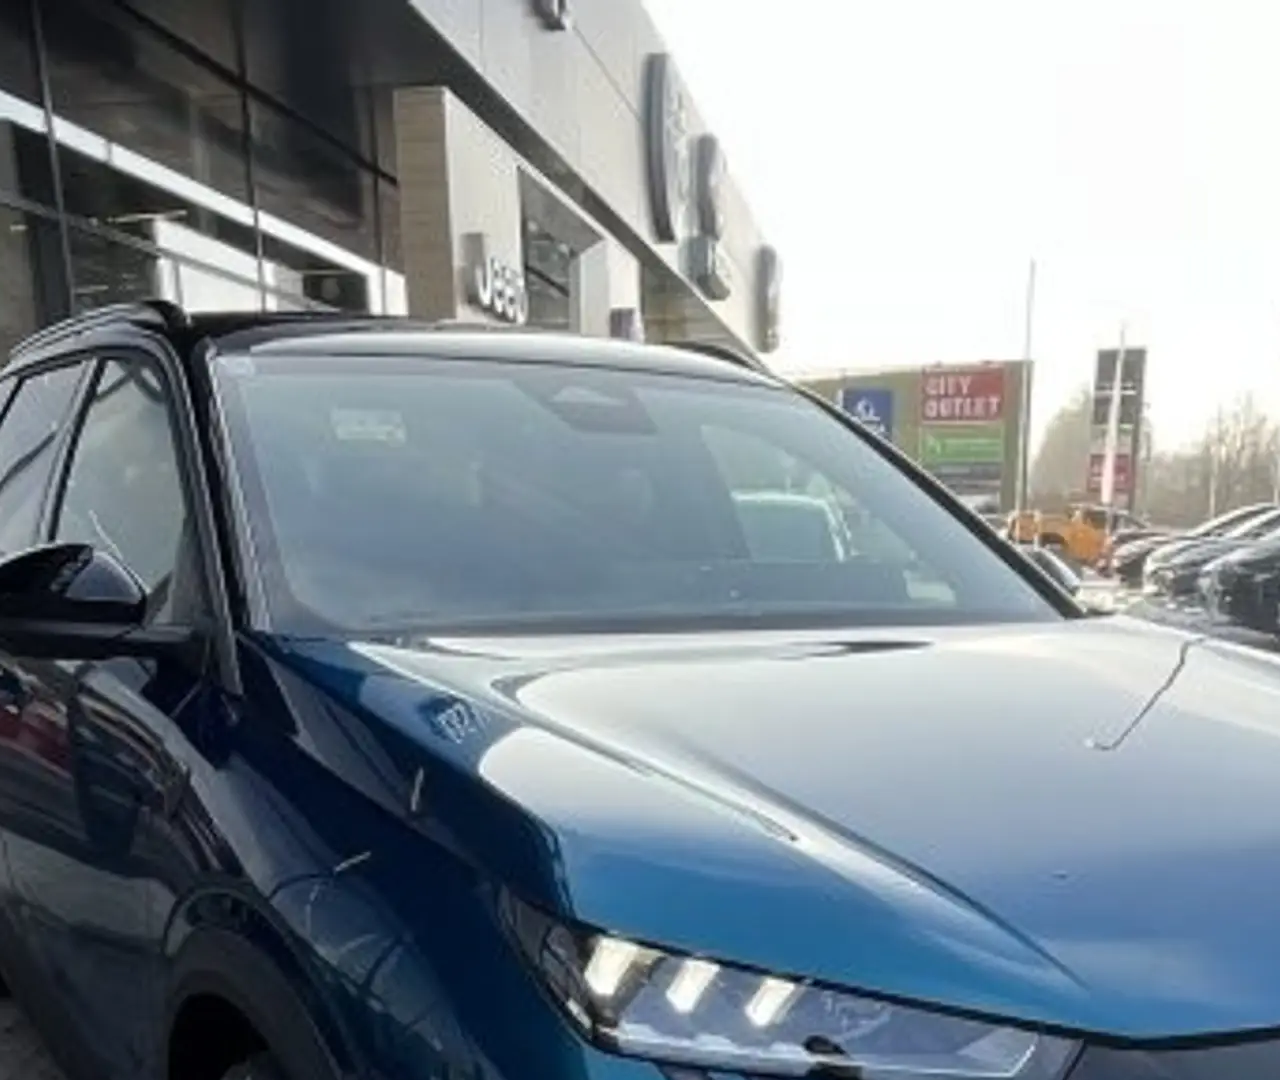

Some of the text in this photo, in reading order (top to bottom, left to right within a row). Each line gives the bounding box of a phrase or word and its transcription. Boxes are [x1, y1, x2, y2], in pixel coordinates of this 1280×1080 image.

[468, 234, 529, 325] Jeep
[924, 375, 973, 396] CITY
[924, 396, 1001, 419] OUTLET
